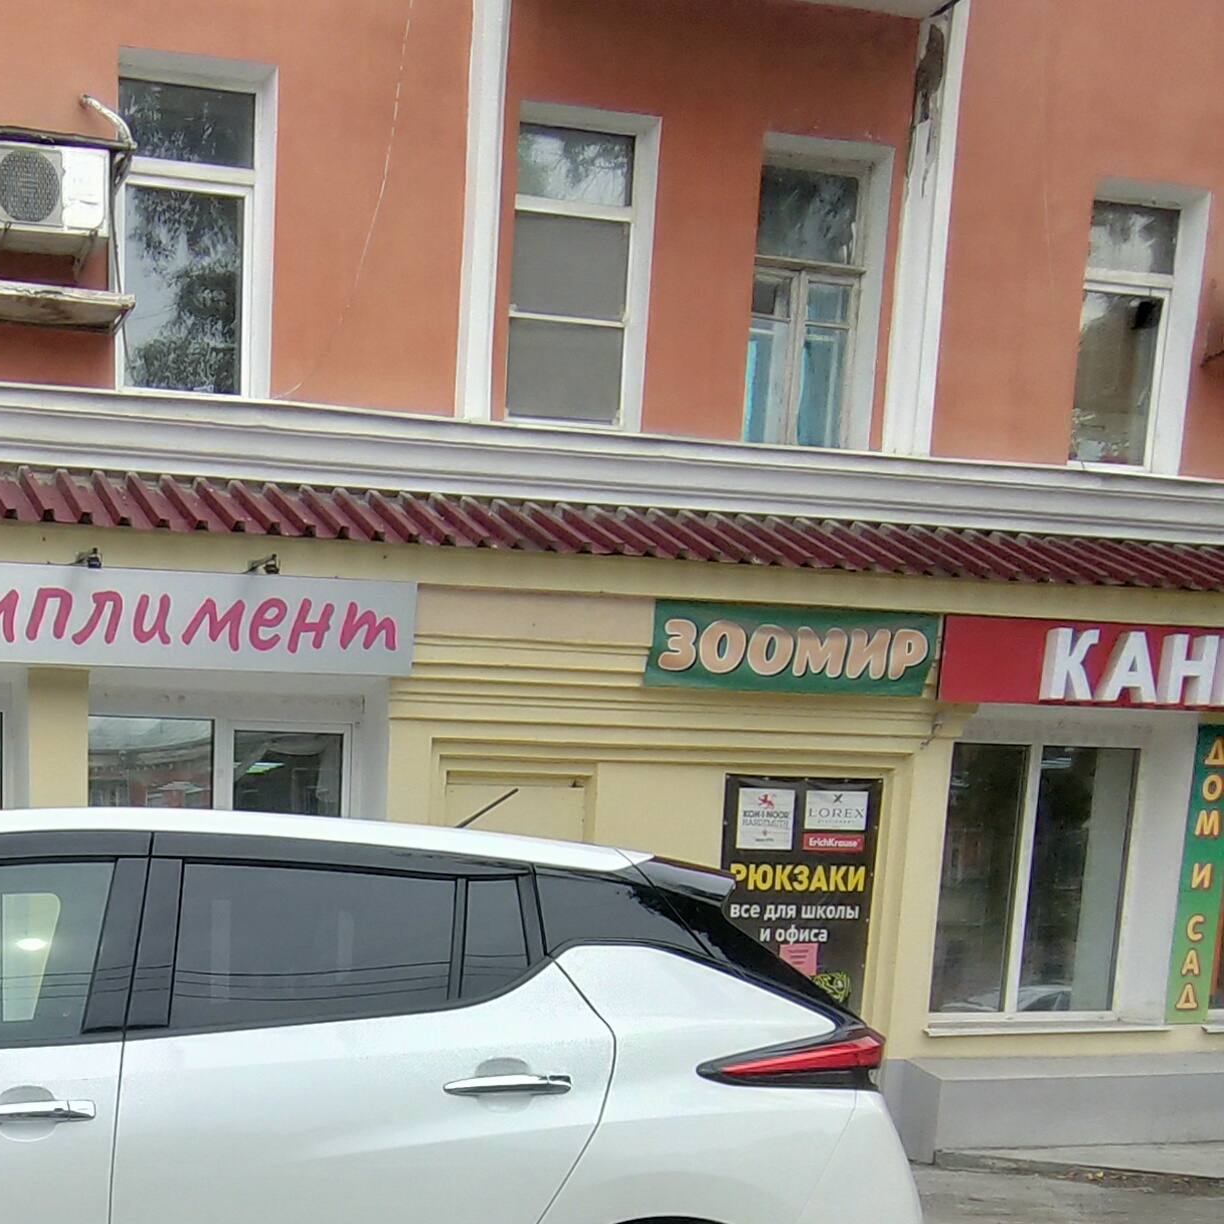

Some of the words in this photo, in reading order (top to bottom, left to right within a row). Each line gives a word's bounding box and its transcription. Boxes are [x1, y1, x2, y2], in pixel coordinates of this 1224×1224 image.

[658, 617, 930, 681] ЗООМИР
[1038, 627, 1224, 708] КАН
[809, 807, 865, 818] LOREX
[730, 863, 866, 892] РЮКЗАКИ
[1190, 861, 1213, 891] И
[730, 903, 760, 918] все
[764, 904, 797, 919] для
[801, 904, 860, 919] школы
[759, 927, 771, 942] и
[775, 925, 828, 945] офиса
[1175, 913, 1205, 1011] САД
